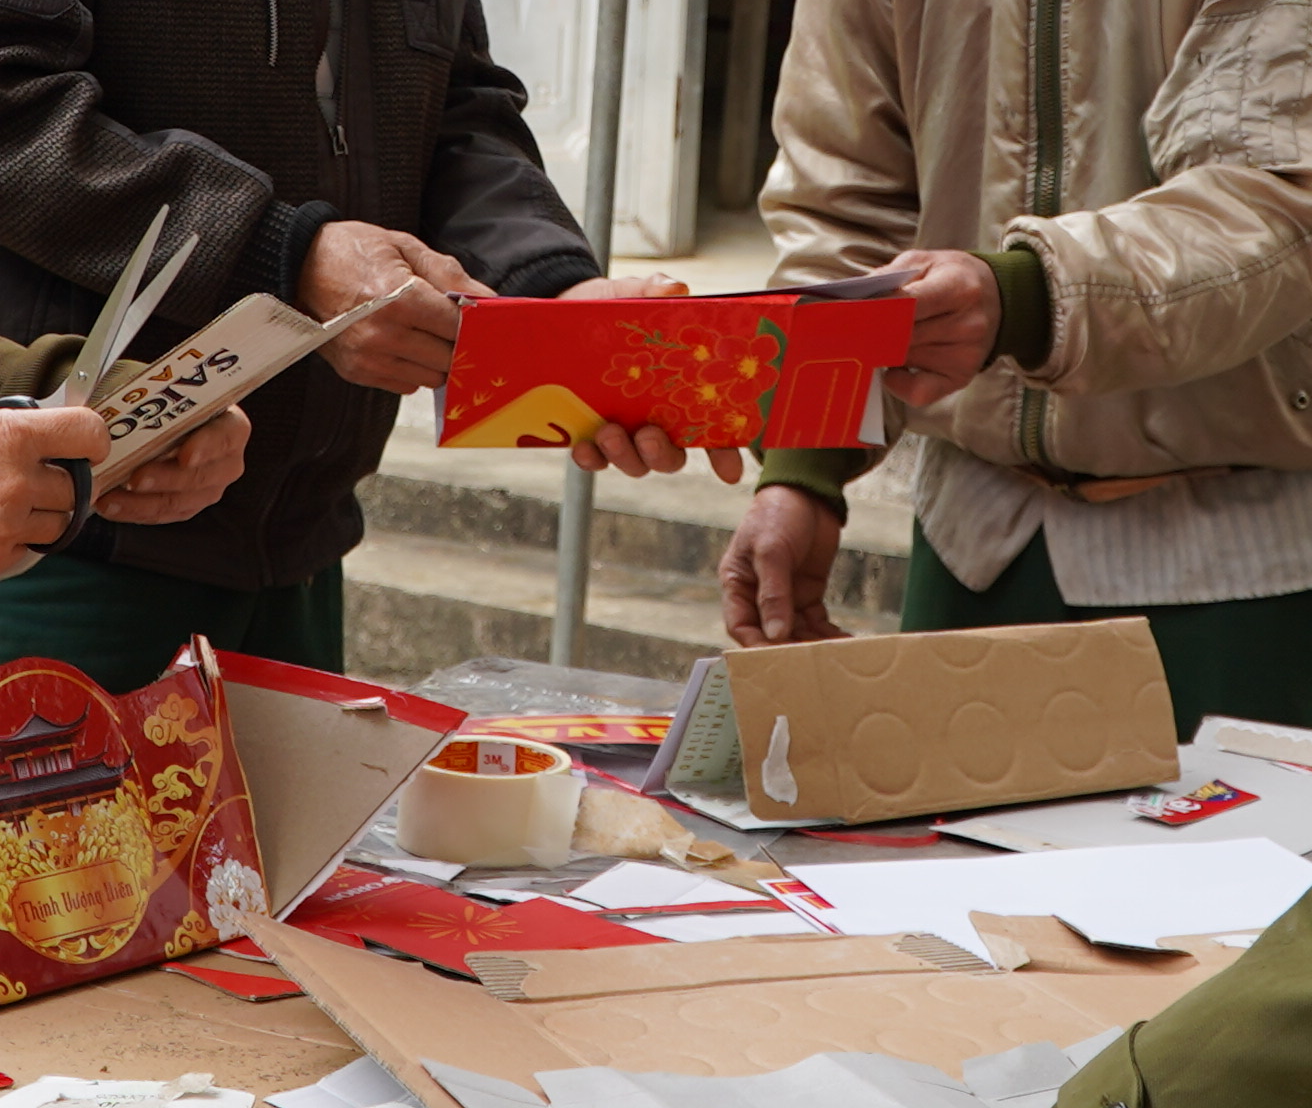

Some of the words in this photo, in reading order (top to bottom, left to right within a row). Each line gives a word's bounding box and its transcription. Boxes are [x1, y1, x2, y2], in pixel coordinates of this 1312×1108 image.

[98, 348, 204, 423] LAGE
[109, 348, 239, 441] SAIGO
[139, 399, 198, 430] BIA
[483, 754, 502, 765] 3M
[19, 895, 65, 924] Thịnh
[61, 890, 106, 920] Vượng
